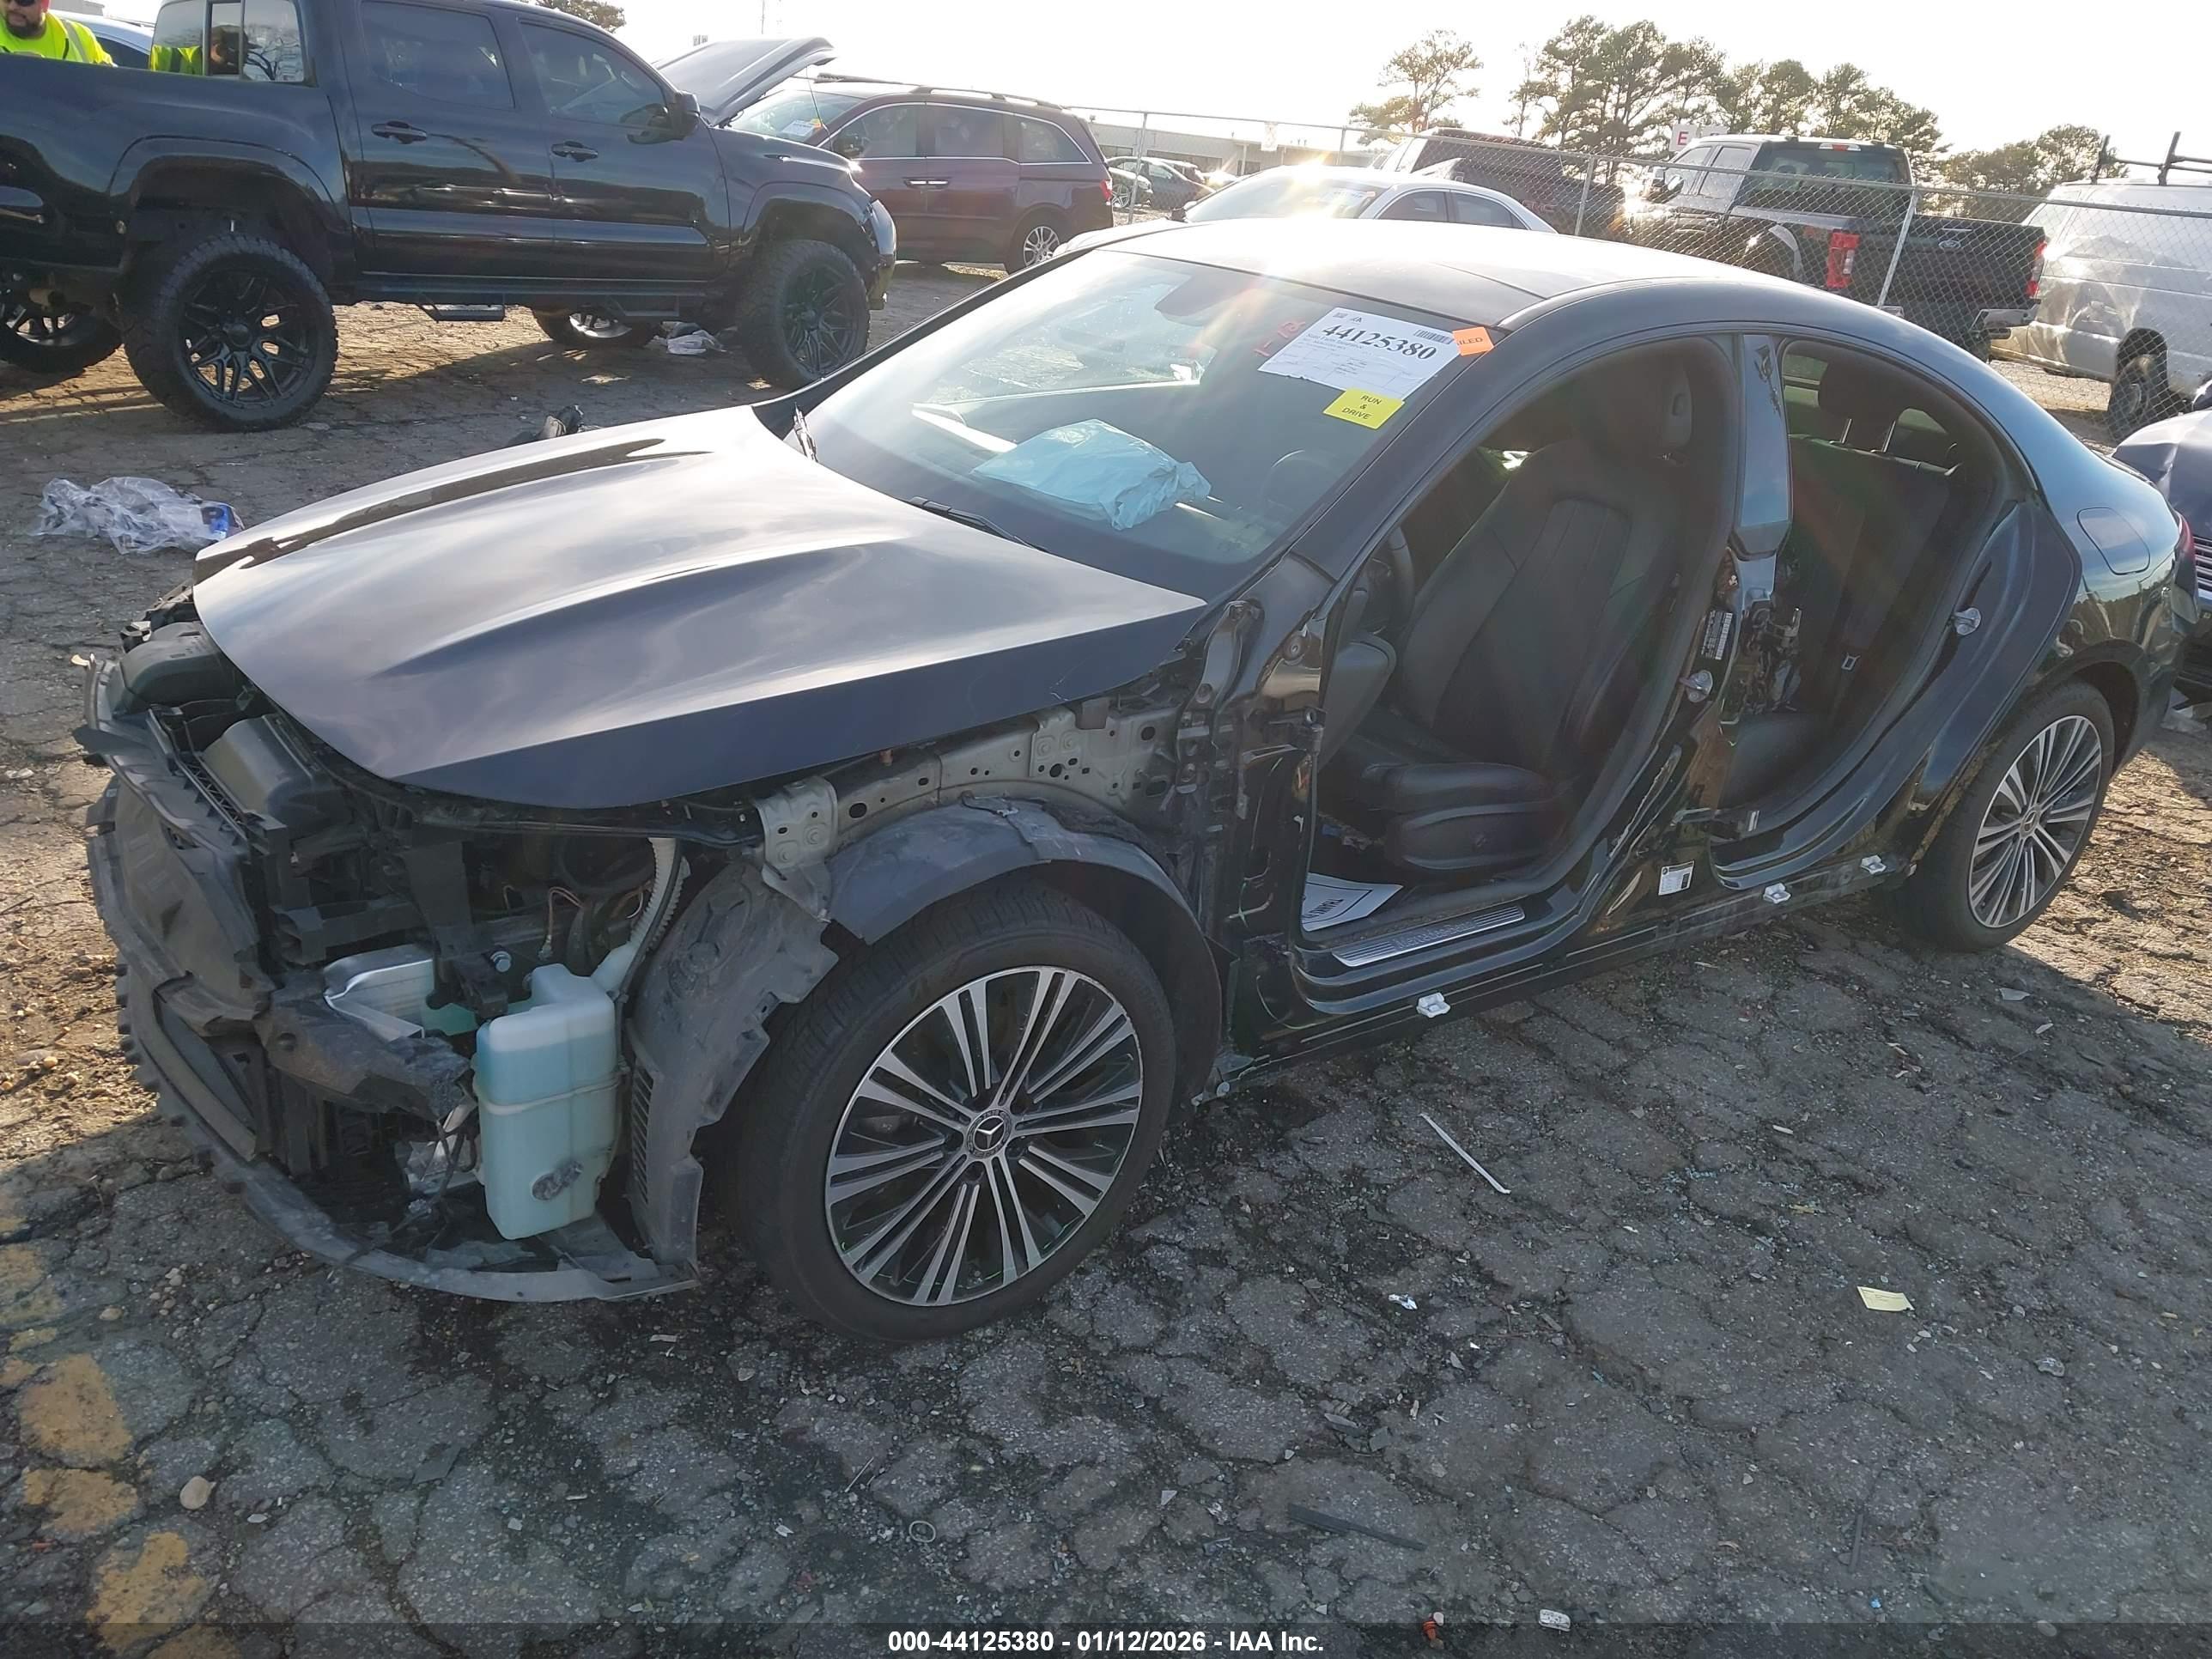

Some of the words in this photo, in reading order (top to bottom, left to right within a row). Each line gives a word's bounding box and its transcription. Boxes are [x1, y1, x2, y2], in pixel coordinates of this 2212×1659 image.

[1677, 131, 1689, 146] E
[1322, 325, 1437, 360] 44125380
[1360, 395, 1382, 405] RUN
[1341, 407, 1372, 420] DRIVE
